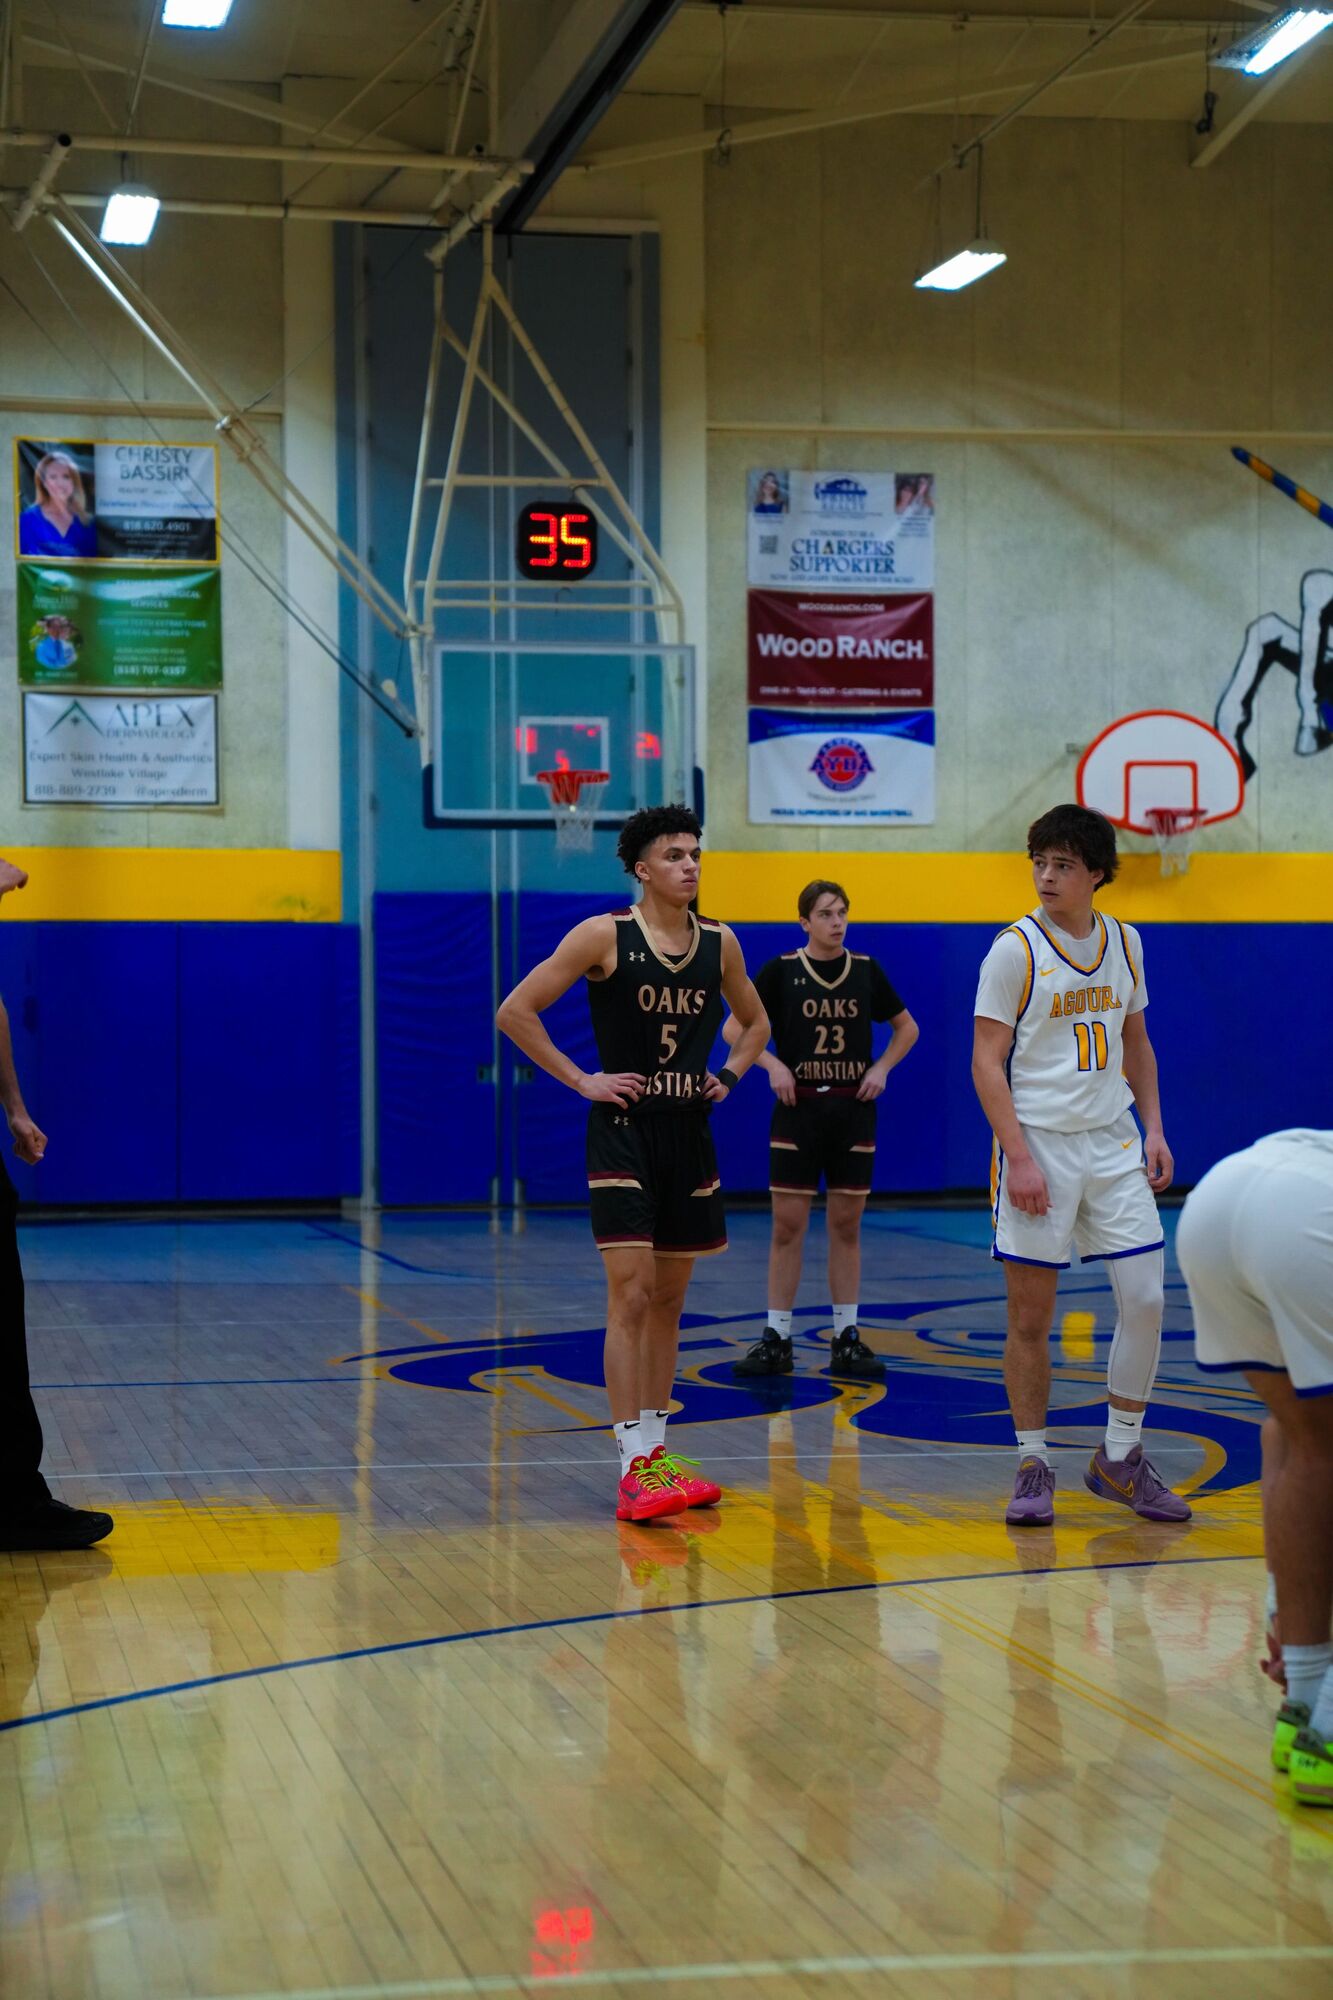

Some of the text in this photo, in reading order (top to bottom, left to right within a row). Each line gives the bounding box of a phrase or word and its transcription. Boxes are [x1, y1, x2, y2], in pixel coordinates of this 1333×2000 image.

[115, 446, 192, 463] CHRISTY
[529, 513, 591, 567] 35
[791, 538, 896, 556] CHARGERS
[790, 555, 896, 574] SUPPORTER
[757, 633, 925, 660] WOOD RANCH
[107, 703, 195, 727] APEX
[29, 751, 64, 765] Expert
[70, 752, 95, 762] Skin
[100, 752, 137, 763] Health
[71, 769, 168, 781] Westlake Village
[638, 984, 706, 1015] OAKS
[802, 999, 859, 1018] OAKS
[658, 1023, 678, 1065] 5
[814, 1025, 846, 1054] 23
[1073, 1021, 1109, 1072] 11
[795, 1061, 867, 1080] CHRISTIAN
